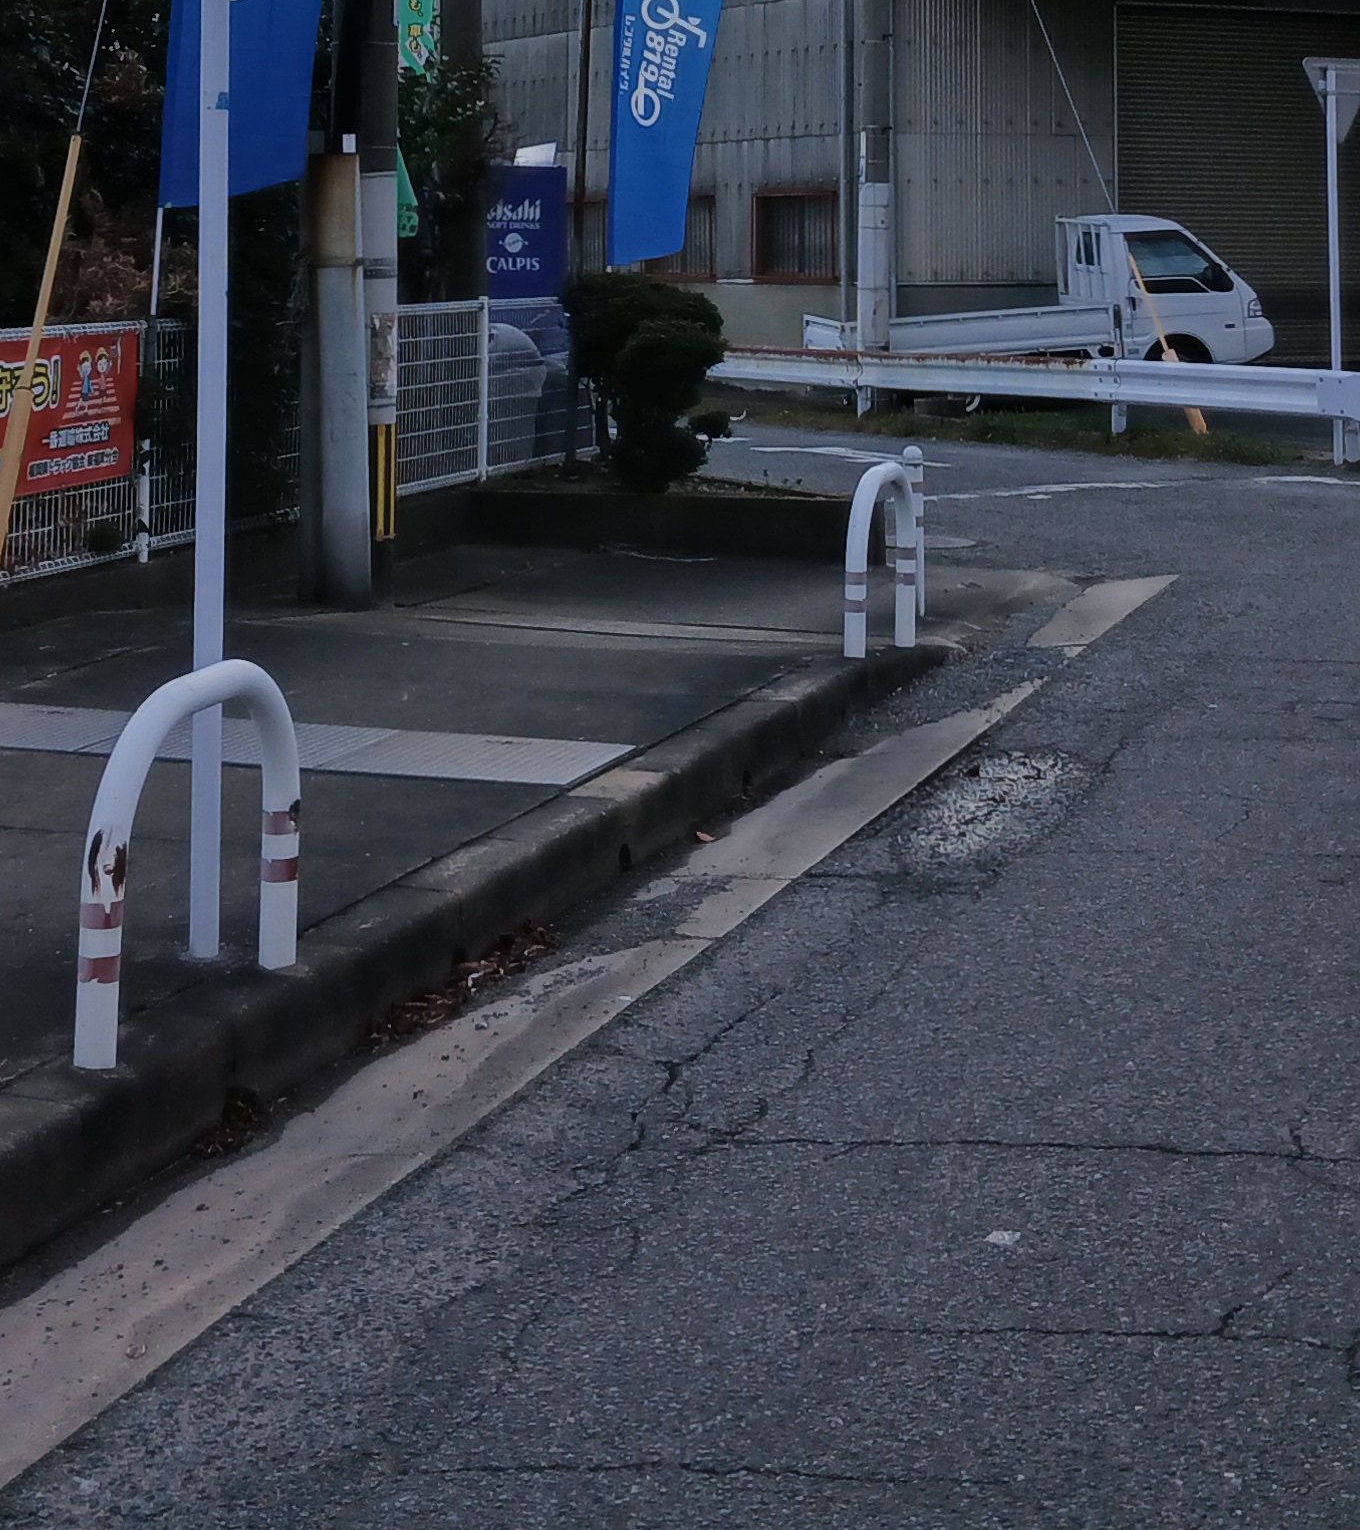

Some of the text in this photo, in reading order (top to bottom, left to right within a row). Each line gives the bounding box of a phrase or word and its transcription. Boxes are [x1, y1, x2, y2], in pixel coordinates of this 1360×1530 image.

[641, 29, 666, 84] 819
[656, 28, 688, 101] Rental
[486, 198, 542, 222] Asahi
[509, 221, 541, 230] DRINKS
[485, 256, 541, 274] CALPIS
